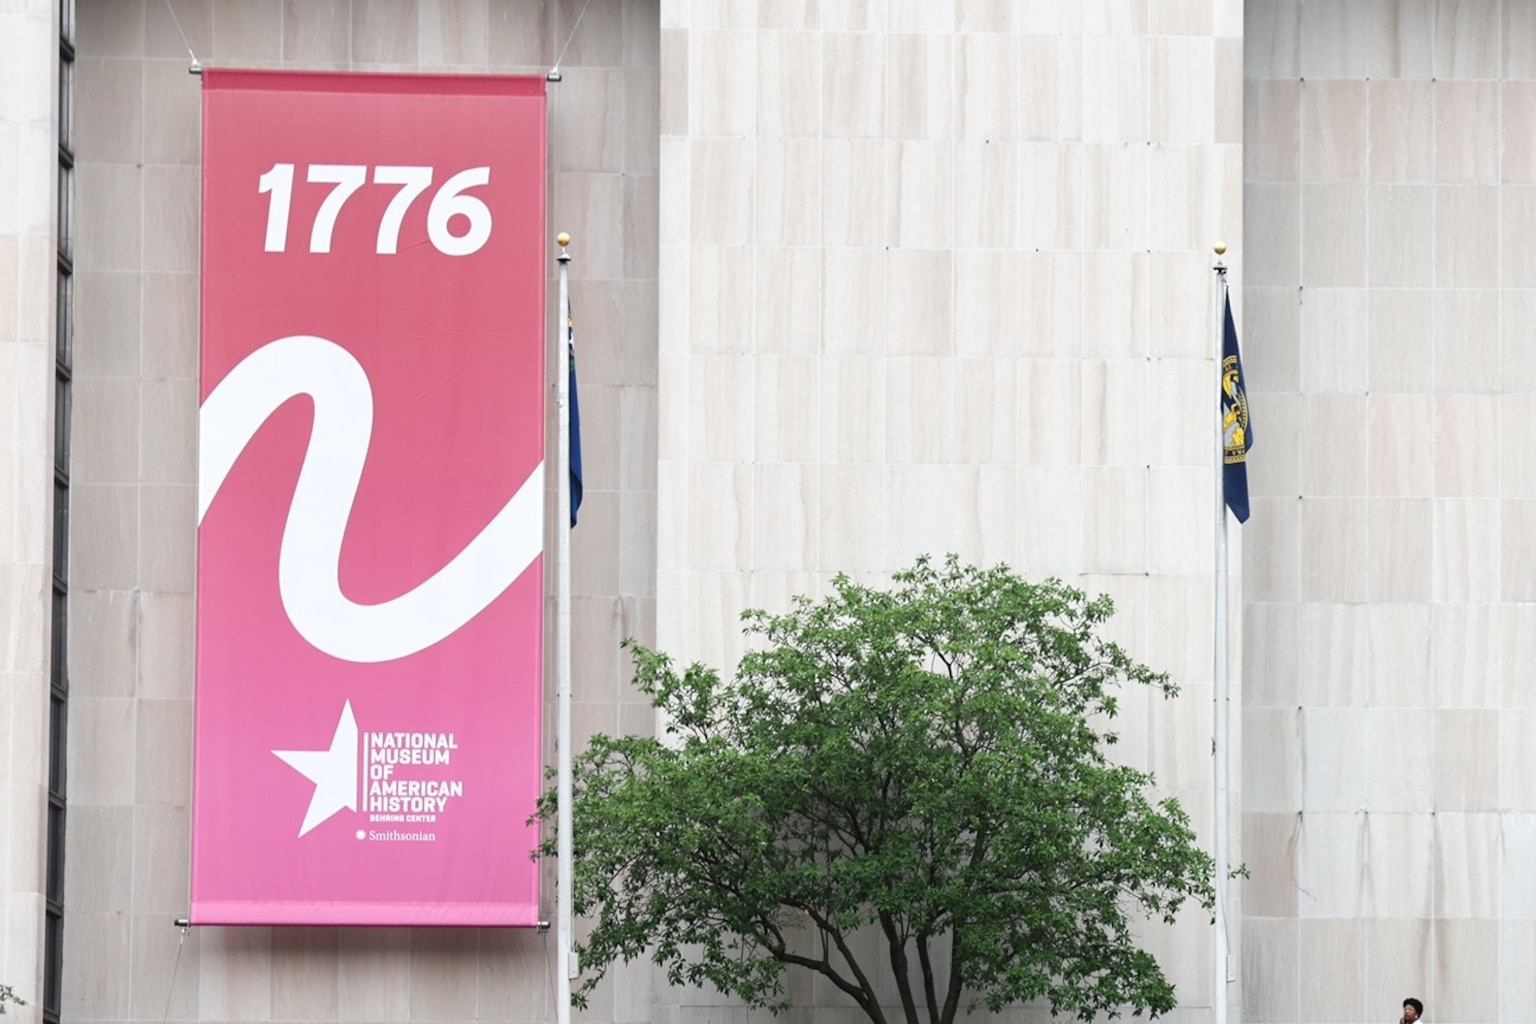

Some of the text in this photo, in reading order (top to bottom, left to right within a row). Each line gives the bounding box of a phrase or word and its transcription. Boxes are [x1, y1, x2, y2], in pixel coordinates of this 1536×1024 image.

[257, 162, 493, 256] 1776
[371, 732, 458, 749] NATIONAL
[371, 749, 450, 765] MUSEUM
[370, 765, 394, 780] OF
[369, 780, 463, 797] AMERICAN
[369, 797, 447, 812] HISTORY
[370, 814, 436, 823] BEHRING CENTER
[369, 830, 436, 841] Smithsonian
